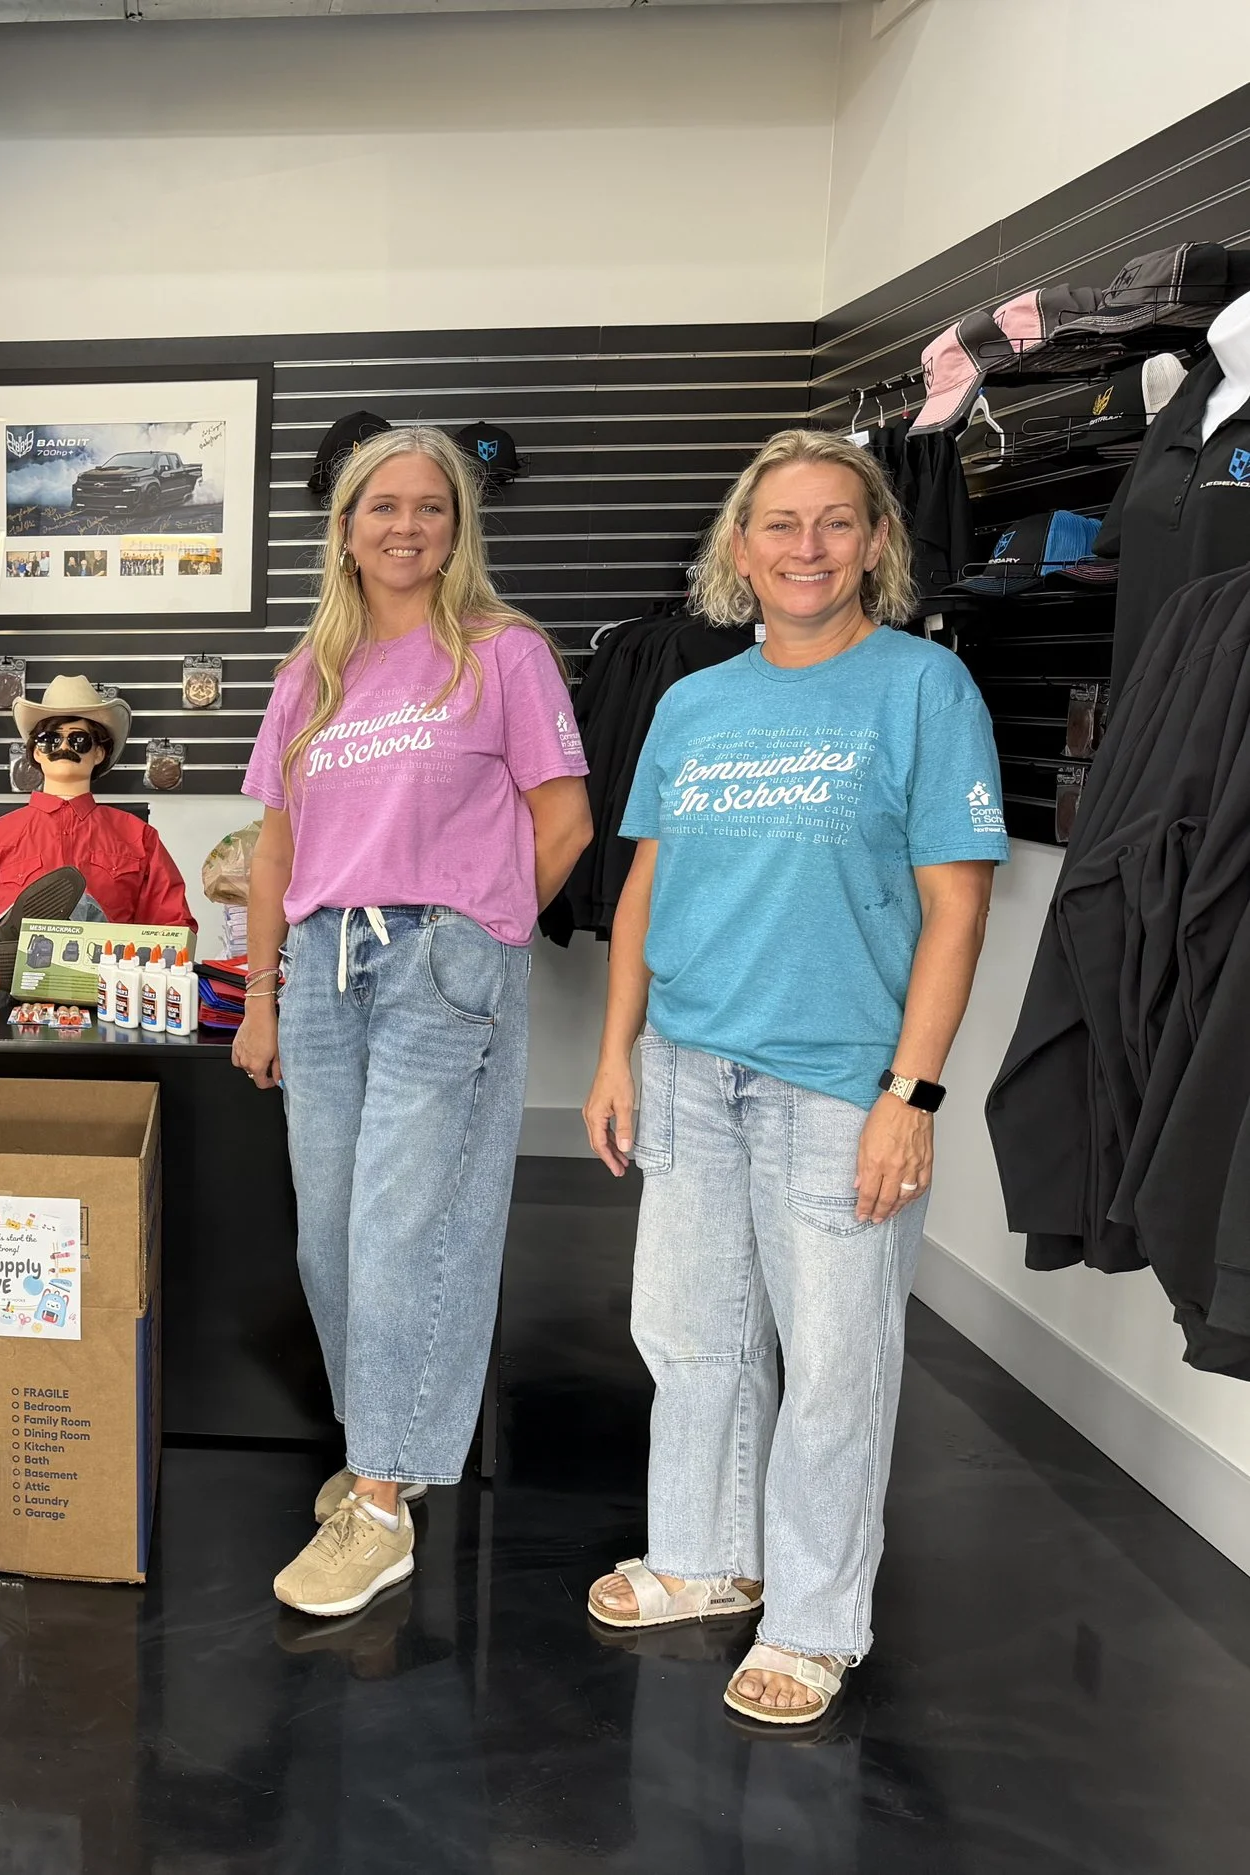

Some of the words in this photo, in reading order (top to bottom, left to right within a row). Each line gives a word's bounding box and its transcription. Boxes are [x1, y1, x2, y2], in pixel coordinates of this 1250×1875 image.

[36, 438, 89, 447] BANDIT
[310, 701, 452, 746] ommunities
[850, 728, 879, 740] calm
[306, 748, 335, 777] In
[338, 726, 434, 768] Schools
[674, 744, 858, 788] Communities
[673, 785, 710, 816] In
[713, 775, 832, 812] Schools
[824, 805, 856, 818] calm
[796, 814, 852, 834] humility
[812, 833, 848, 846] guide
[30, 924, 47, 932] MESH
[6, 1234, 24, 1242] start
[26, 1234, 37, 1242] the
[24, 1388, 69, 1398] FRAGILE
[24, 1402, 72, 1412] Bedroom
[24, 1415, 59, 1427] Family
[61, 1417, 90, 1427] Room
[24, 1428, 58, 1440] Dining
[60, 1430, 90, 1440] Room
[24, 1442, 65, 1453] Kitchen
[24, 1455, 49, 1465] Bath
[24, 1469, 78, 1480] Basement
[25, 1482, 50, 1492] Attic
[25, 1495, 69, 1507] Laundry
[25, 1508, 65, 1520] Garage
